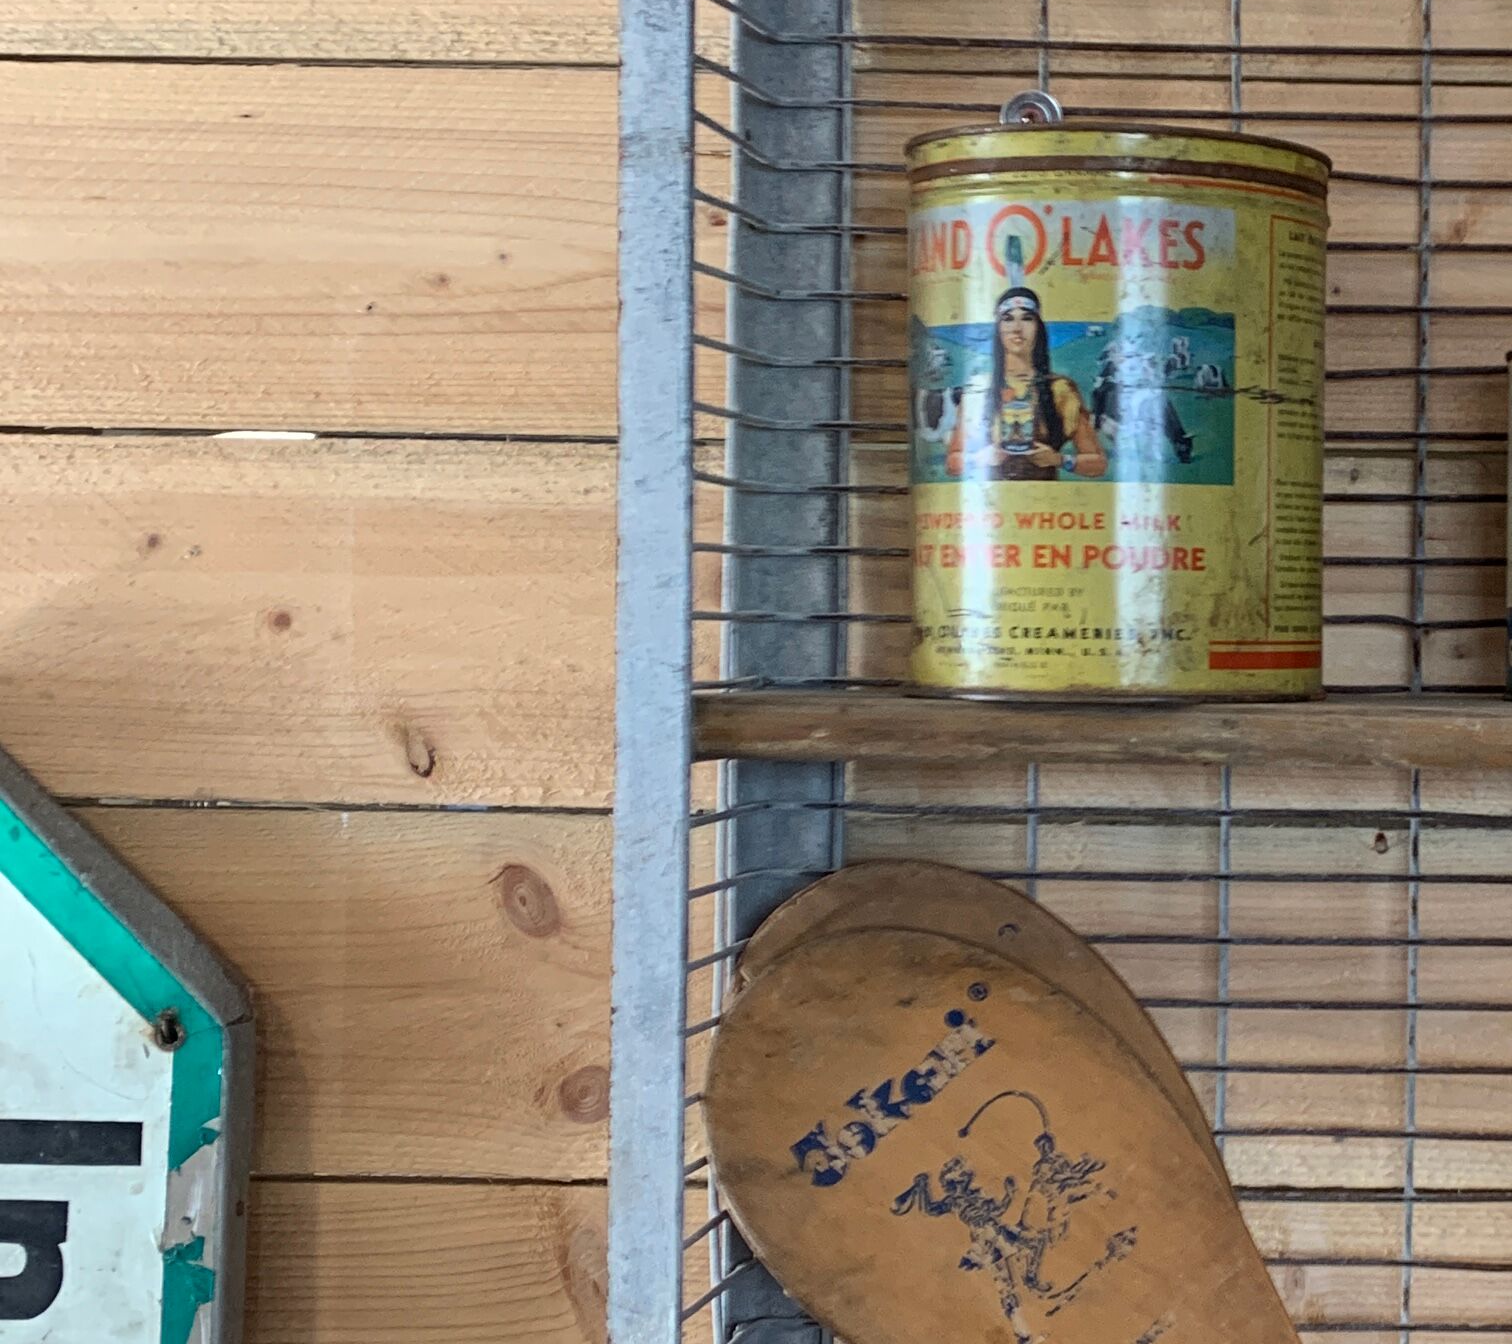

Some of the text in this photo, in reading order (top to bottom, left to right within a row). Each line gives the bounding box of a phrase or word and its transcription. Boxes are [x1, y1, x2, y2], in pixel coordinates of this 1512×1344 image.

[911, 218, 973, 270] AND
[1014, 511, 1106, 531] WHOLE
[1030, 543, 1073, 571] EN
[1081, 544, 1207, 574] POUDRE
